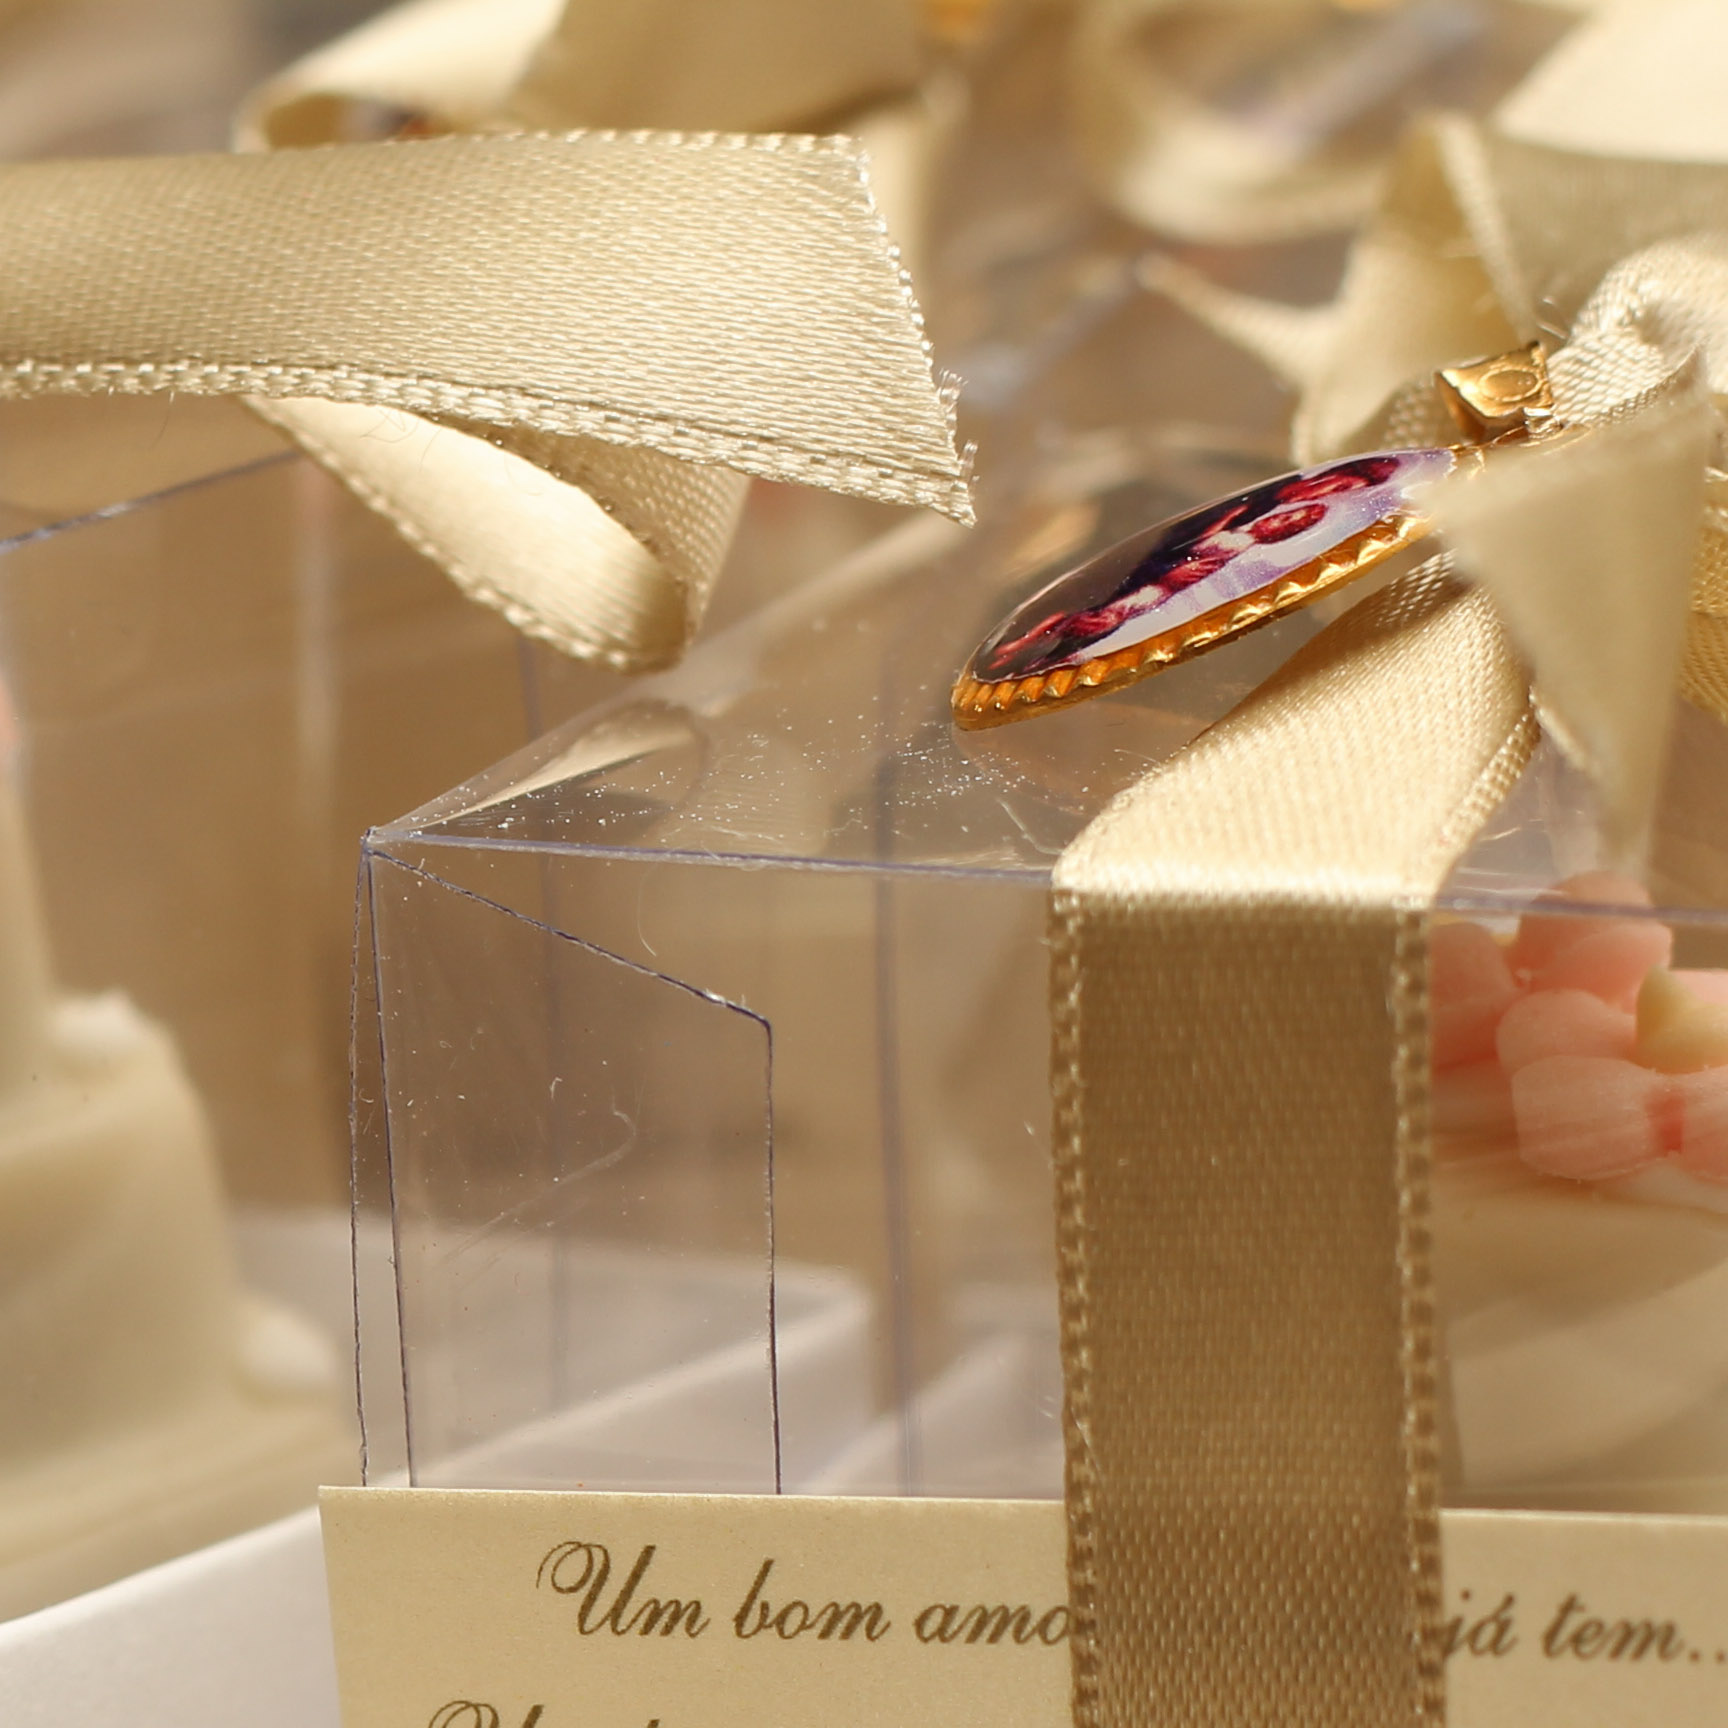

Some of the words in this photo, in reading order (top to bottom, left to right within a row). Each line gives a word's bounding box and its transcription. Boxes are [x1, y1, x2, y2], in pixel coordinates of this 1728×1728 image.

[536, 1540, 711, 1638] Um
[733, 1558, 890, 1643] bom
[912, 1598, 1069, 1647] amo
